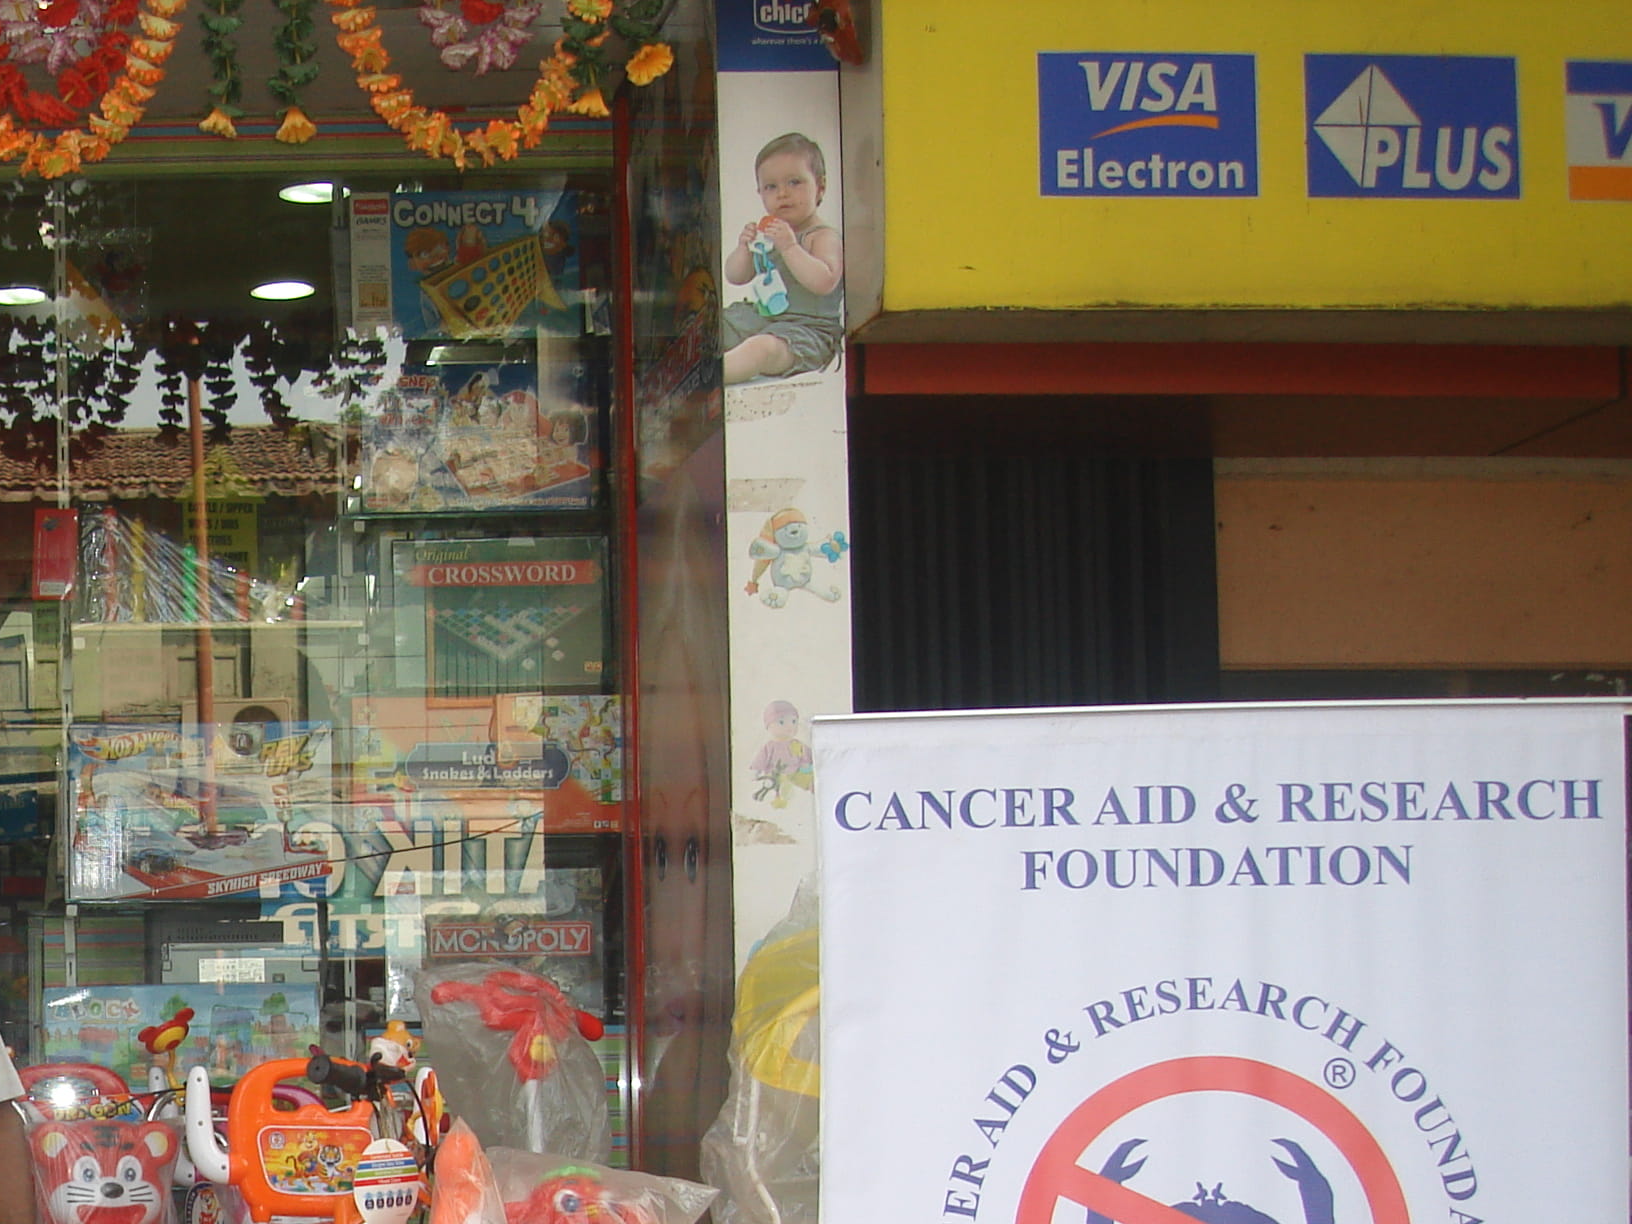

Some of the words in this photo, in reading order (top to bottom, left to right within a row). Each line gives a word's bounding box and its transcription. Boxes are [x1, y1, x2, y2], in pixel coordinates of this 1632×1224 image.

[1078, 61, 1217, 112] VISA
[1055, 148, 1244, 189] Electron
[1367, 125, 1512, 190] PLUS
[393, 199, 507, 227] CONNECT
[511, 196, 539, 227] 4
[428, 564, 576, 584] CROSSWORD
[423, 767, 474, 780] Snakes
[835, 788, 1080, 831] CANCER
[1092, 786, 1196, 825] AID
[1215, 784, 1259, 823] &
[1277, 780, 1602, 822] RESEARCH
[1020, 845, 1413, 890] FOUNDATION
[980, 1062, 1038, 1150] AID
[1043, 1027, 1080, 1065] &
[1082, 976, 1368, 1055] RESEARCH
